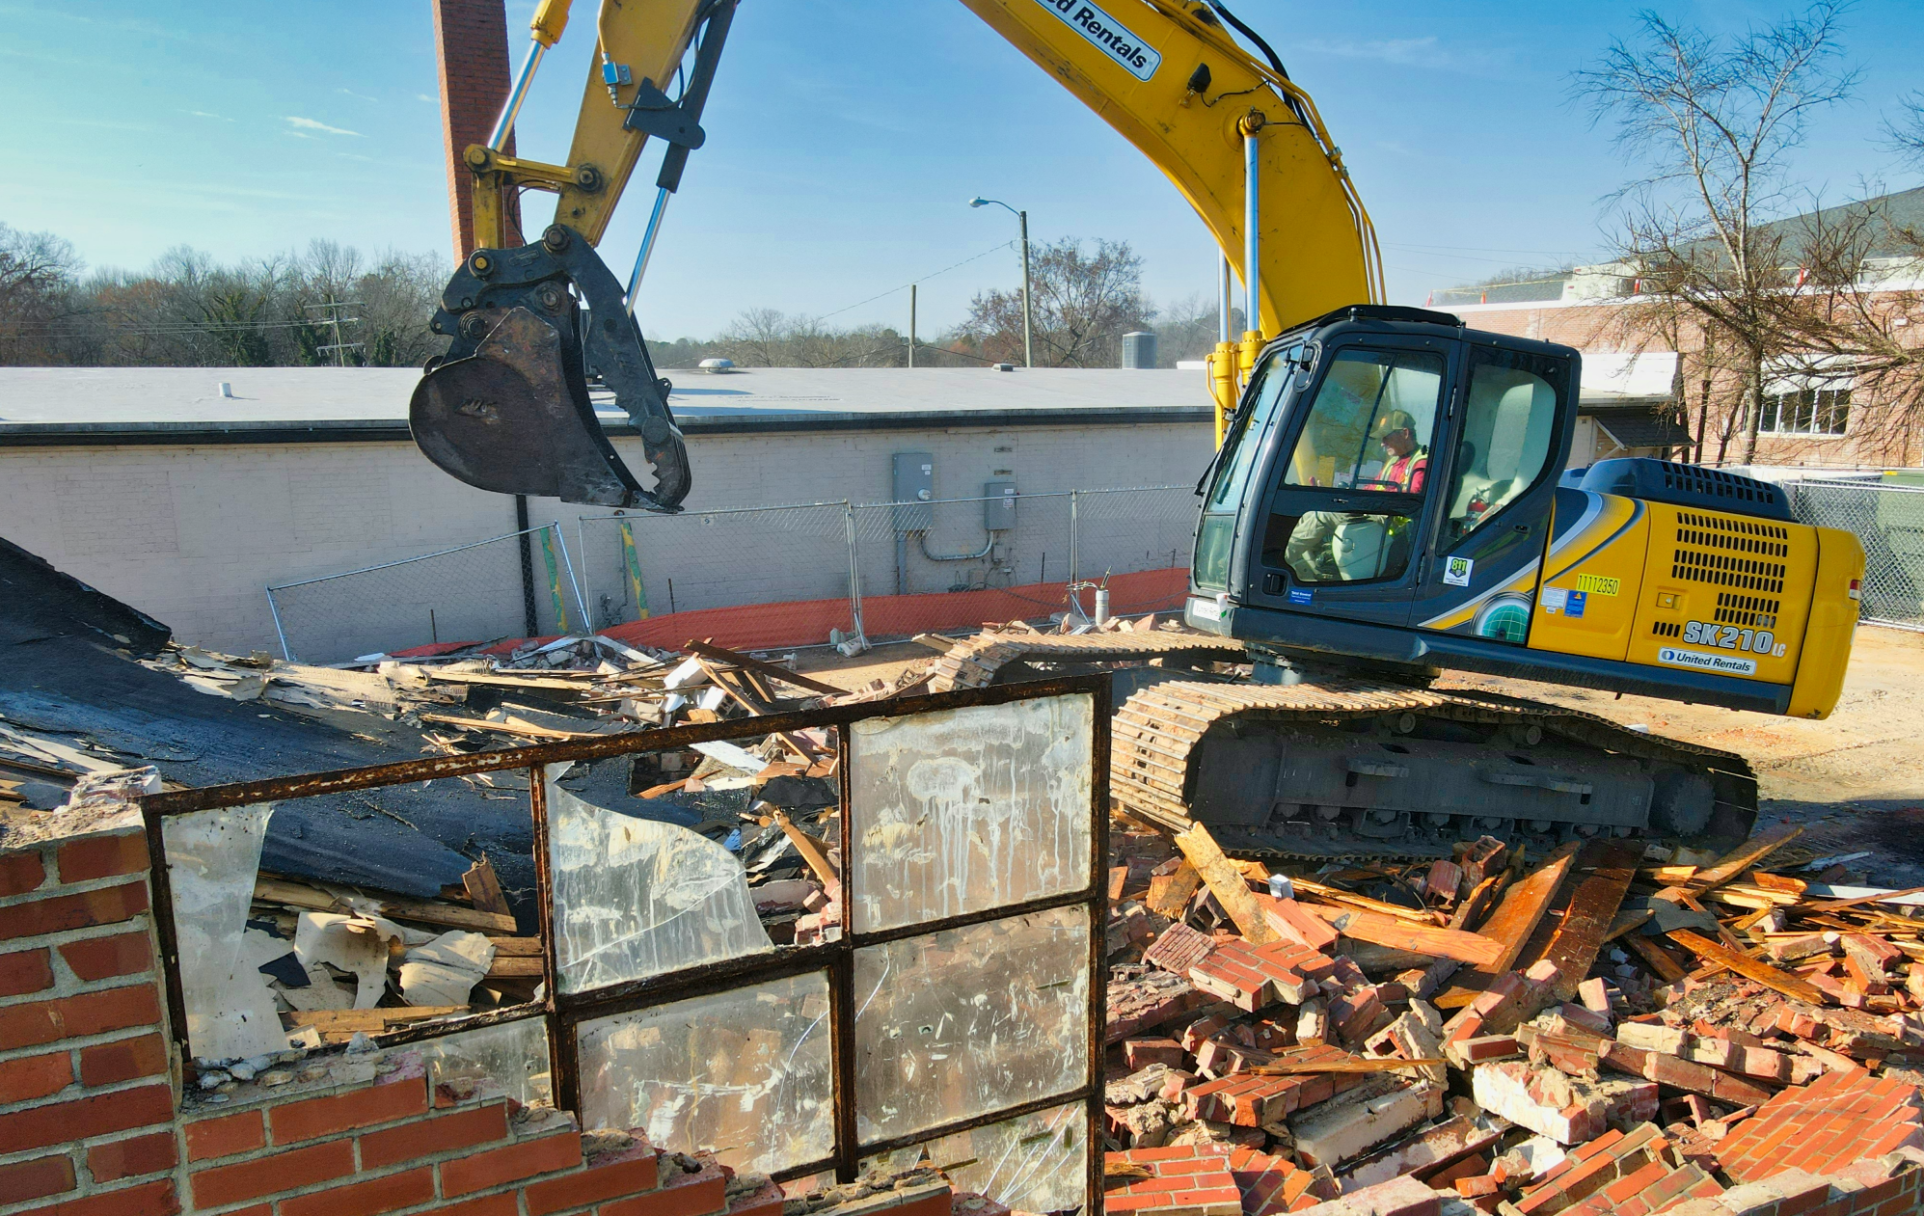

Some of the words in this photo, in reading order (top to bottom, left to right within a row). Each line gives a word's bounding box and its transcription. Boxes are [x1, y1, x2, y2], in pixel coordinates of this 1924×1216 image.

[1047, 0, 1077, 13] d
[1073, 6, 1147, 69] Rentals
[1451, 557, 1467, 571] 811
[1578, 575, 1618, 595] 11112350
[1683, 620, 1774, 654] SK210
[1772, 643, 1786, 657] LC
[1676, 653, 1711, 666] United
[1713, 658, 1751, 672] Rentals
